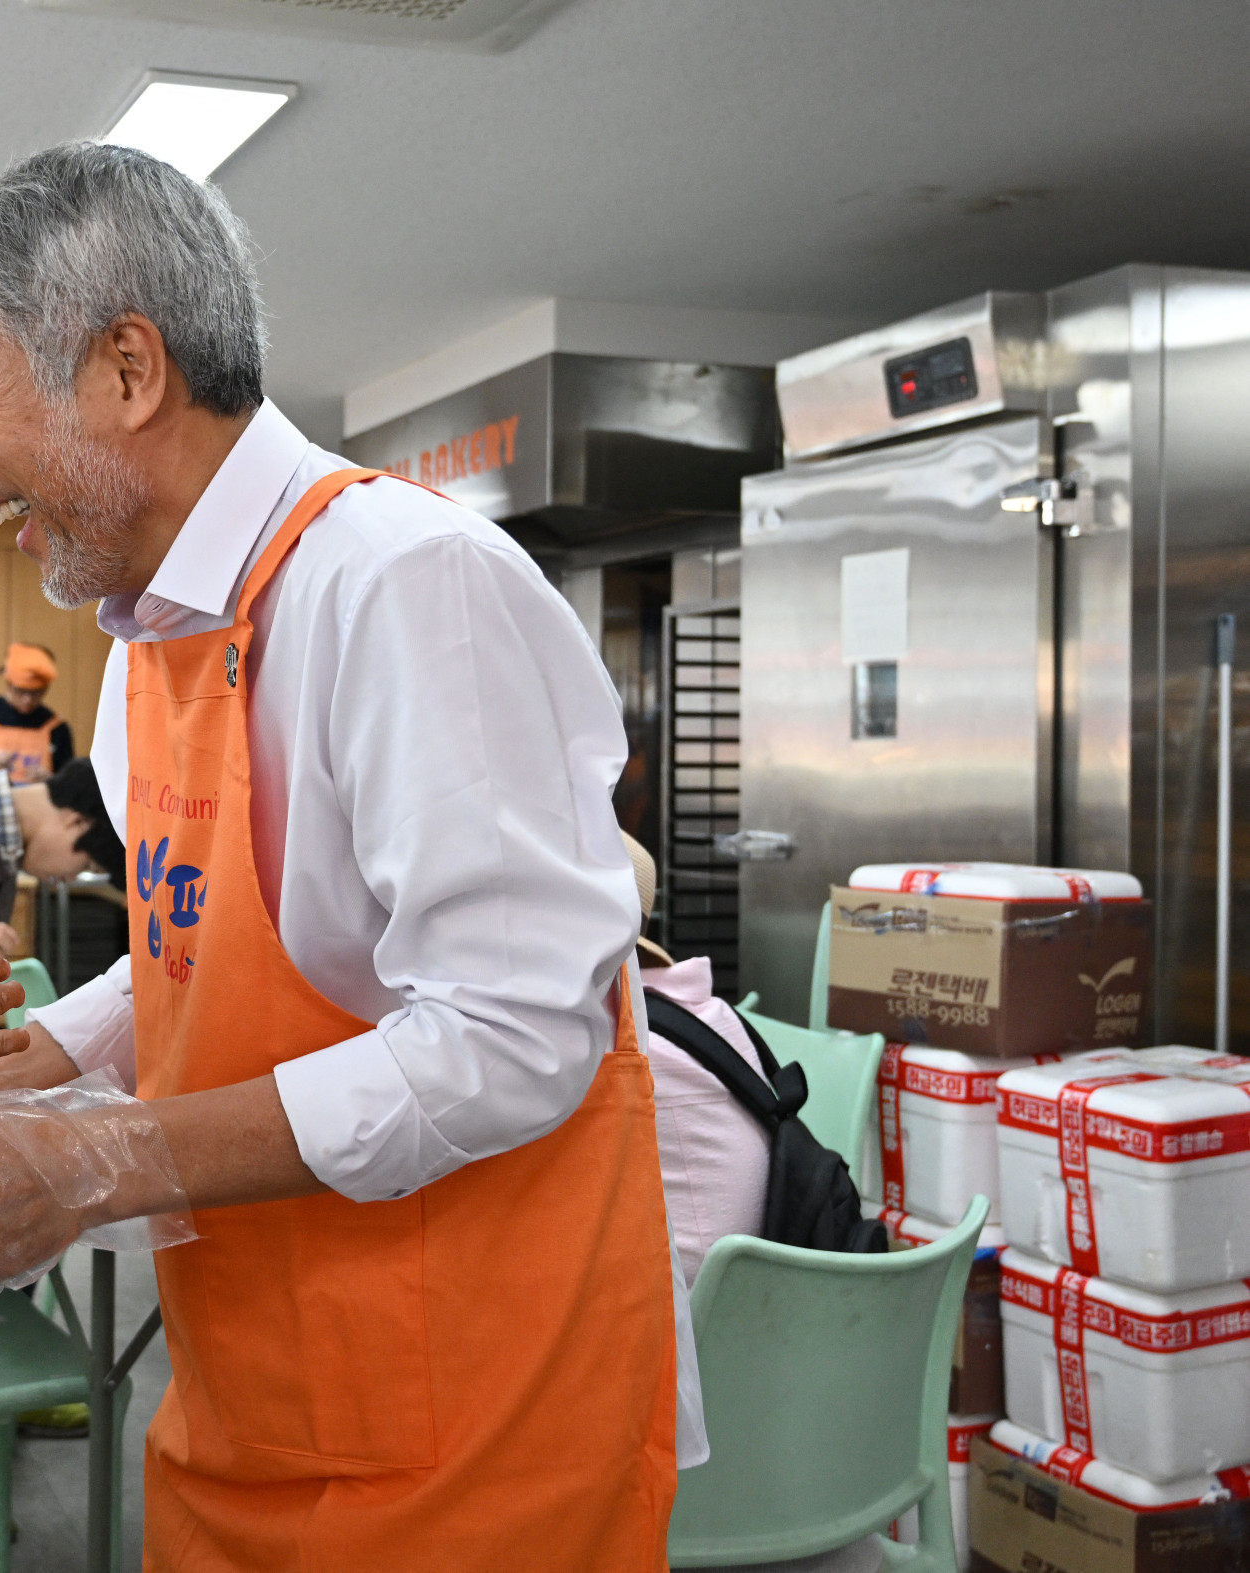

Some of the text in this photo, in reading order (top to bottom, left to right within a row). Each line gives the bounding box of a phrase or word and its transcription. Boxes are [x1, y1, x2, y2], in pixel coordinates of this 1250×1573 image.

[419, 414, 519, 487] BAKERY
[887, 967, 989, 1004] 로젠택배
[886, 997, 990, 1027] 1588-9988
[906, 1066, 965, 1100] 취급주의
